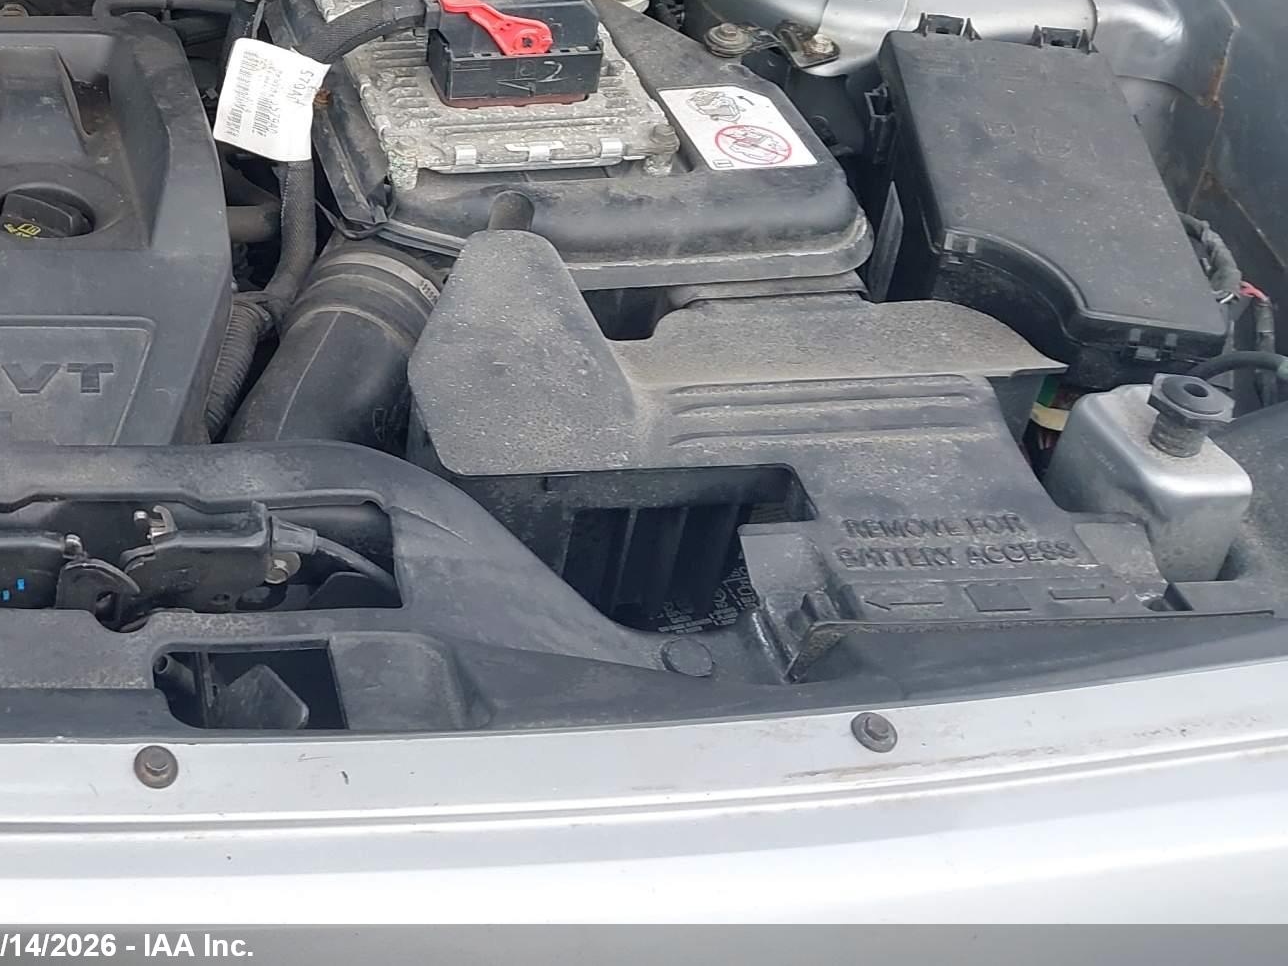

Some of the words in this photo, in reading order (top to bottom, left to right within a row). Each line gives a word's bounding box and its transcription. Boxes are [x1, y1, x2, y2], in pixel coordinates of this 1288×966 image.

[841, 518, 961, 538] REMOVE
[966, 512, 1028, 535] FOR
[835, 545, 957, 569] BATTERY
[966, 539, 1077, 565] ACCESS
